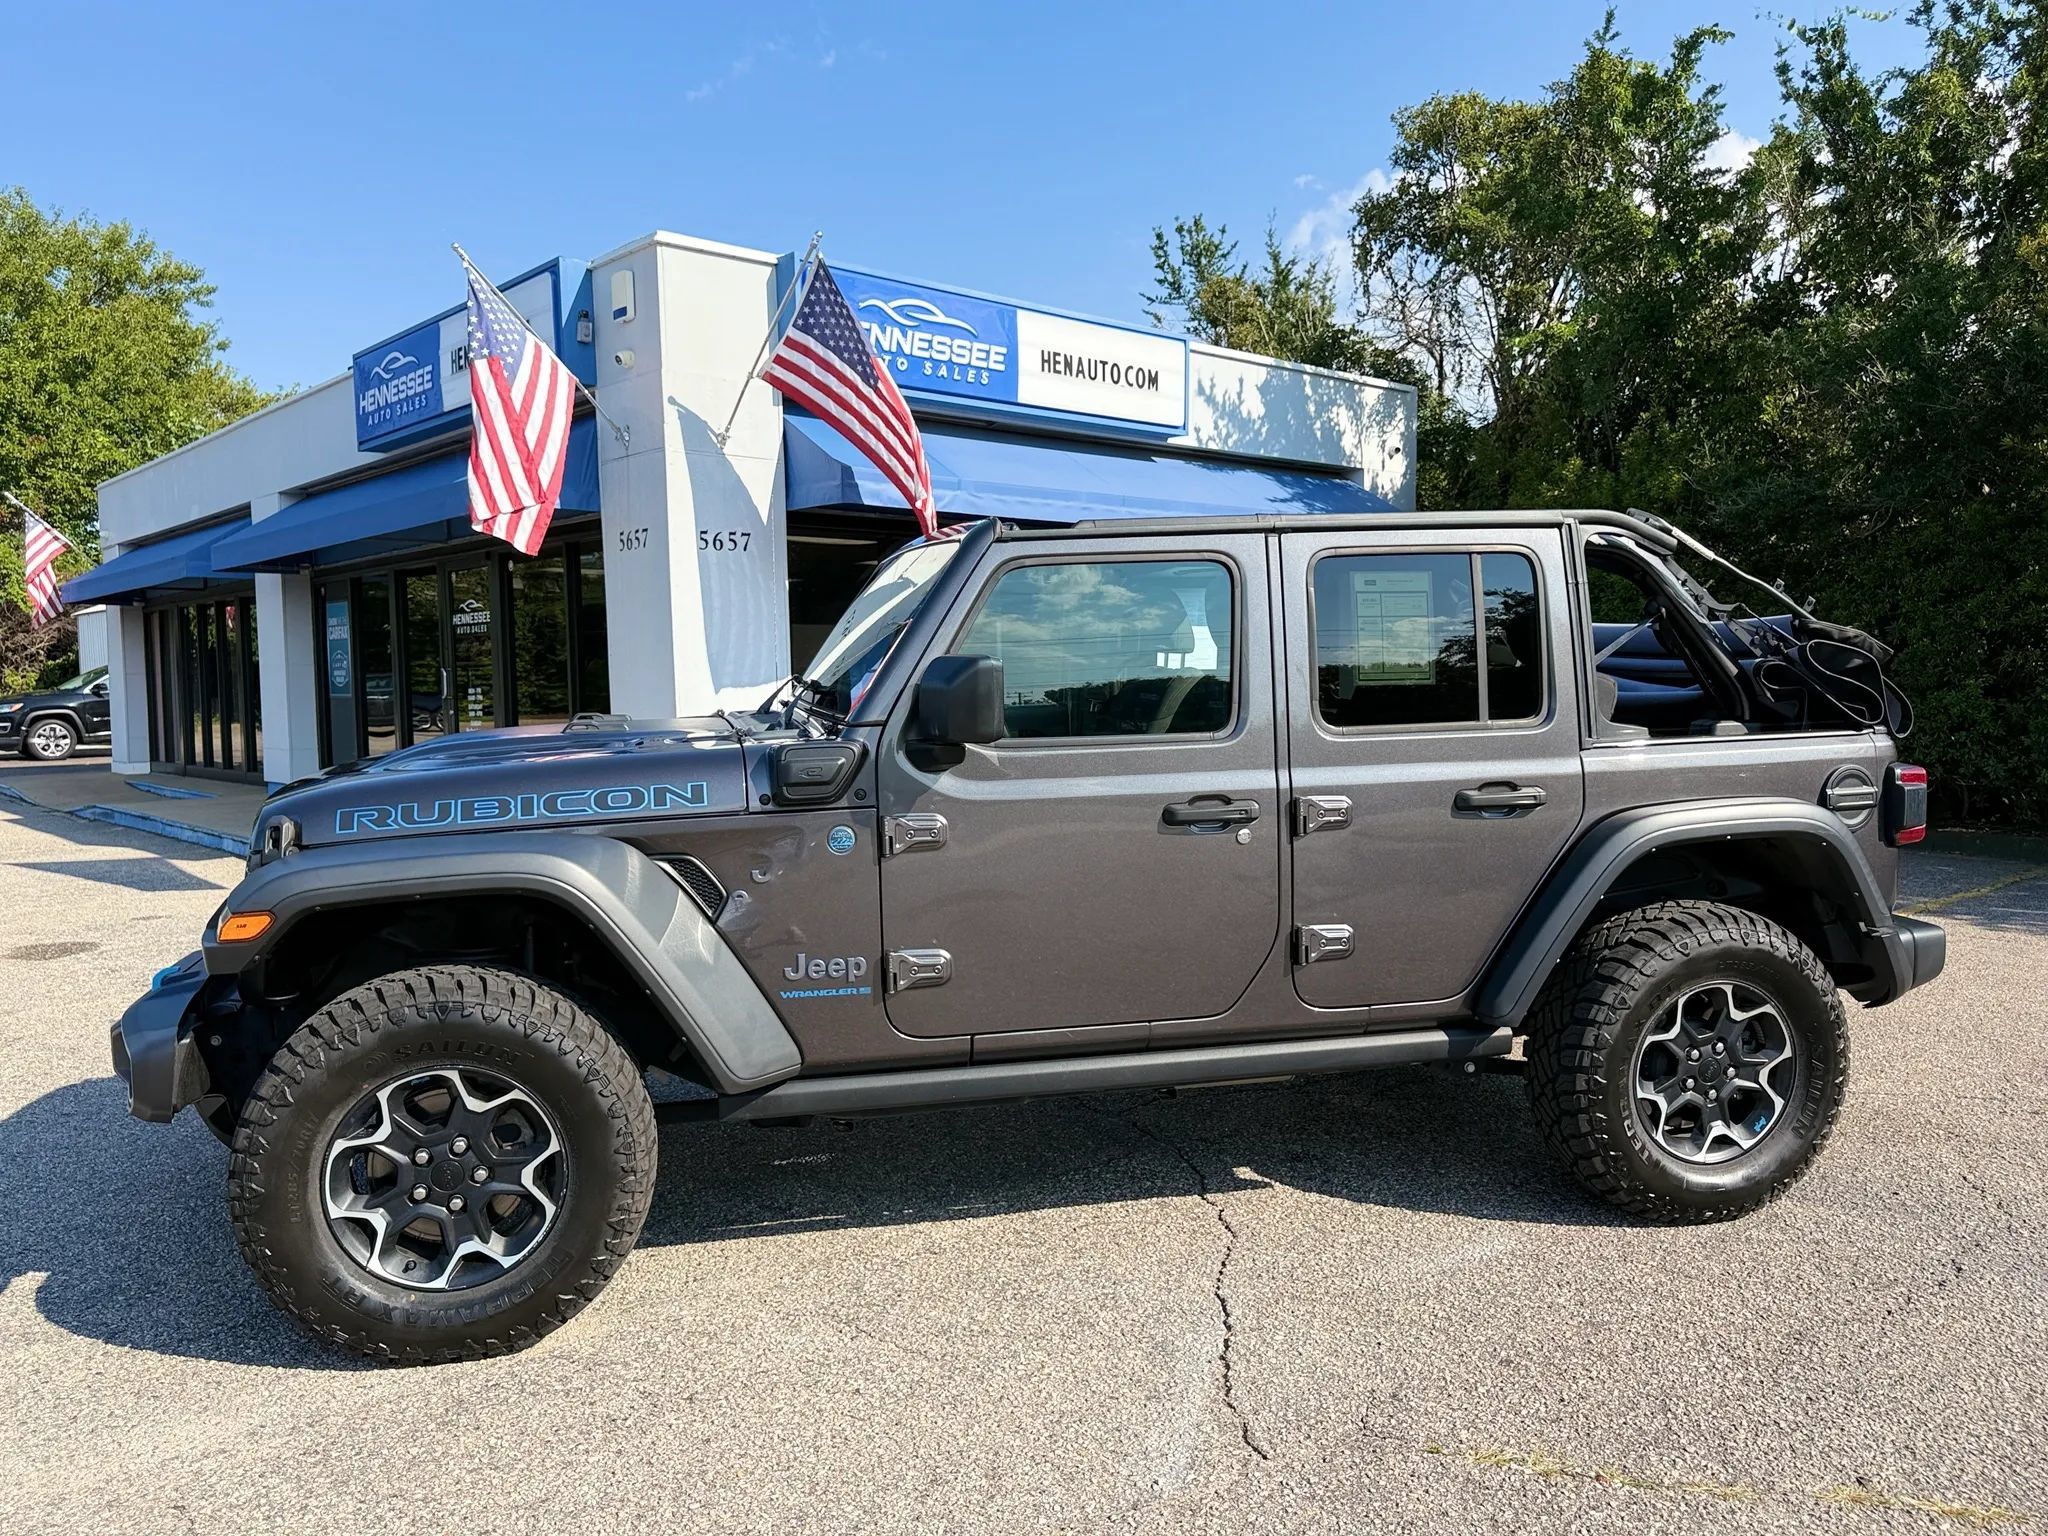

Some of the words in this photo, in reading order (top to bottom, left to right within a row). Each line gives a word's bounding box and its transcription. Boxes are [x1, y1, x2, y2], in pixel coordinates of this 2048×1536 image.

[861, 321, 1007, 371] NNESSEE
[922, 360, 990, 385] SALES
[359, 365, 433, 415] HENNESSEE
[368, 409, 391, 426] AUTO
[397, 395, 427, 416] SALES
[619, 528, 649, 551] 5657
[699, 529, 751, 552] 5657
[452, 611, 491, 625] HENNESSEE
[335, 782, 708, 833] RUBICON
[783, 953, 867, 983] Jeep
[780, 987, 857, 999] WRANGLER
